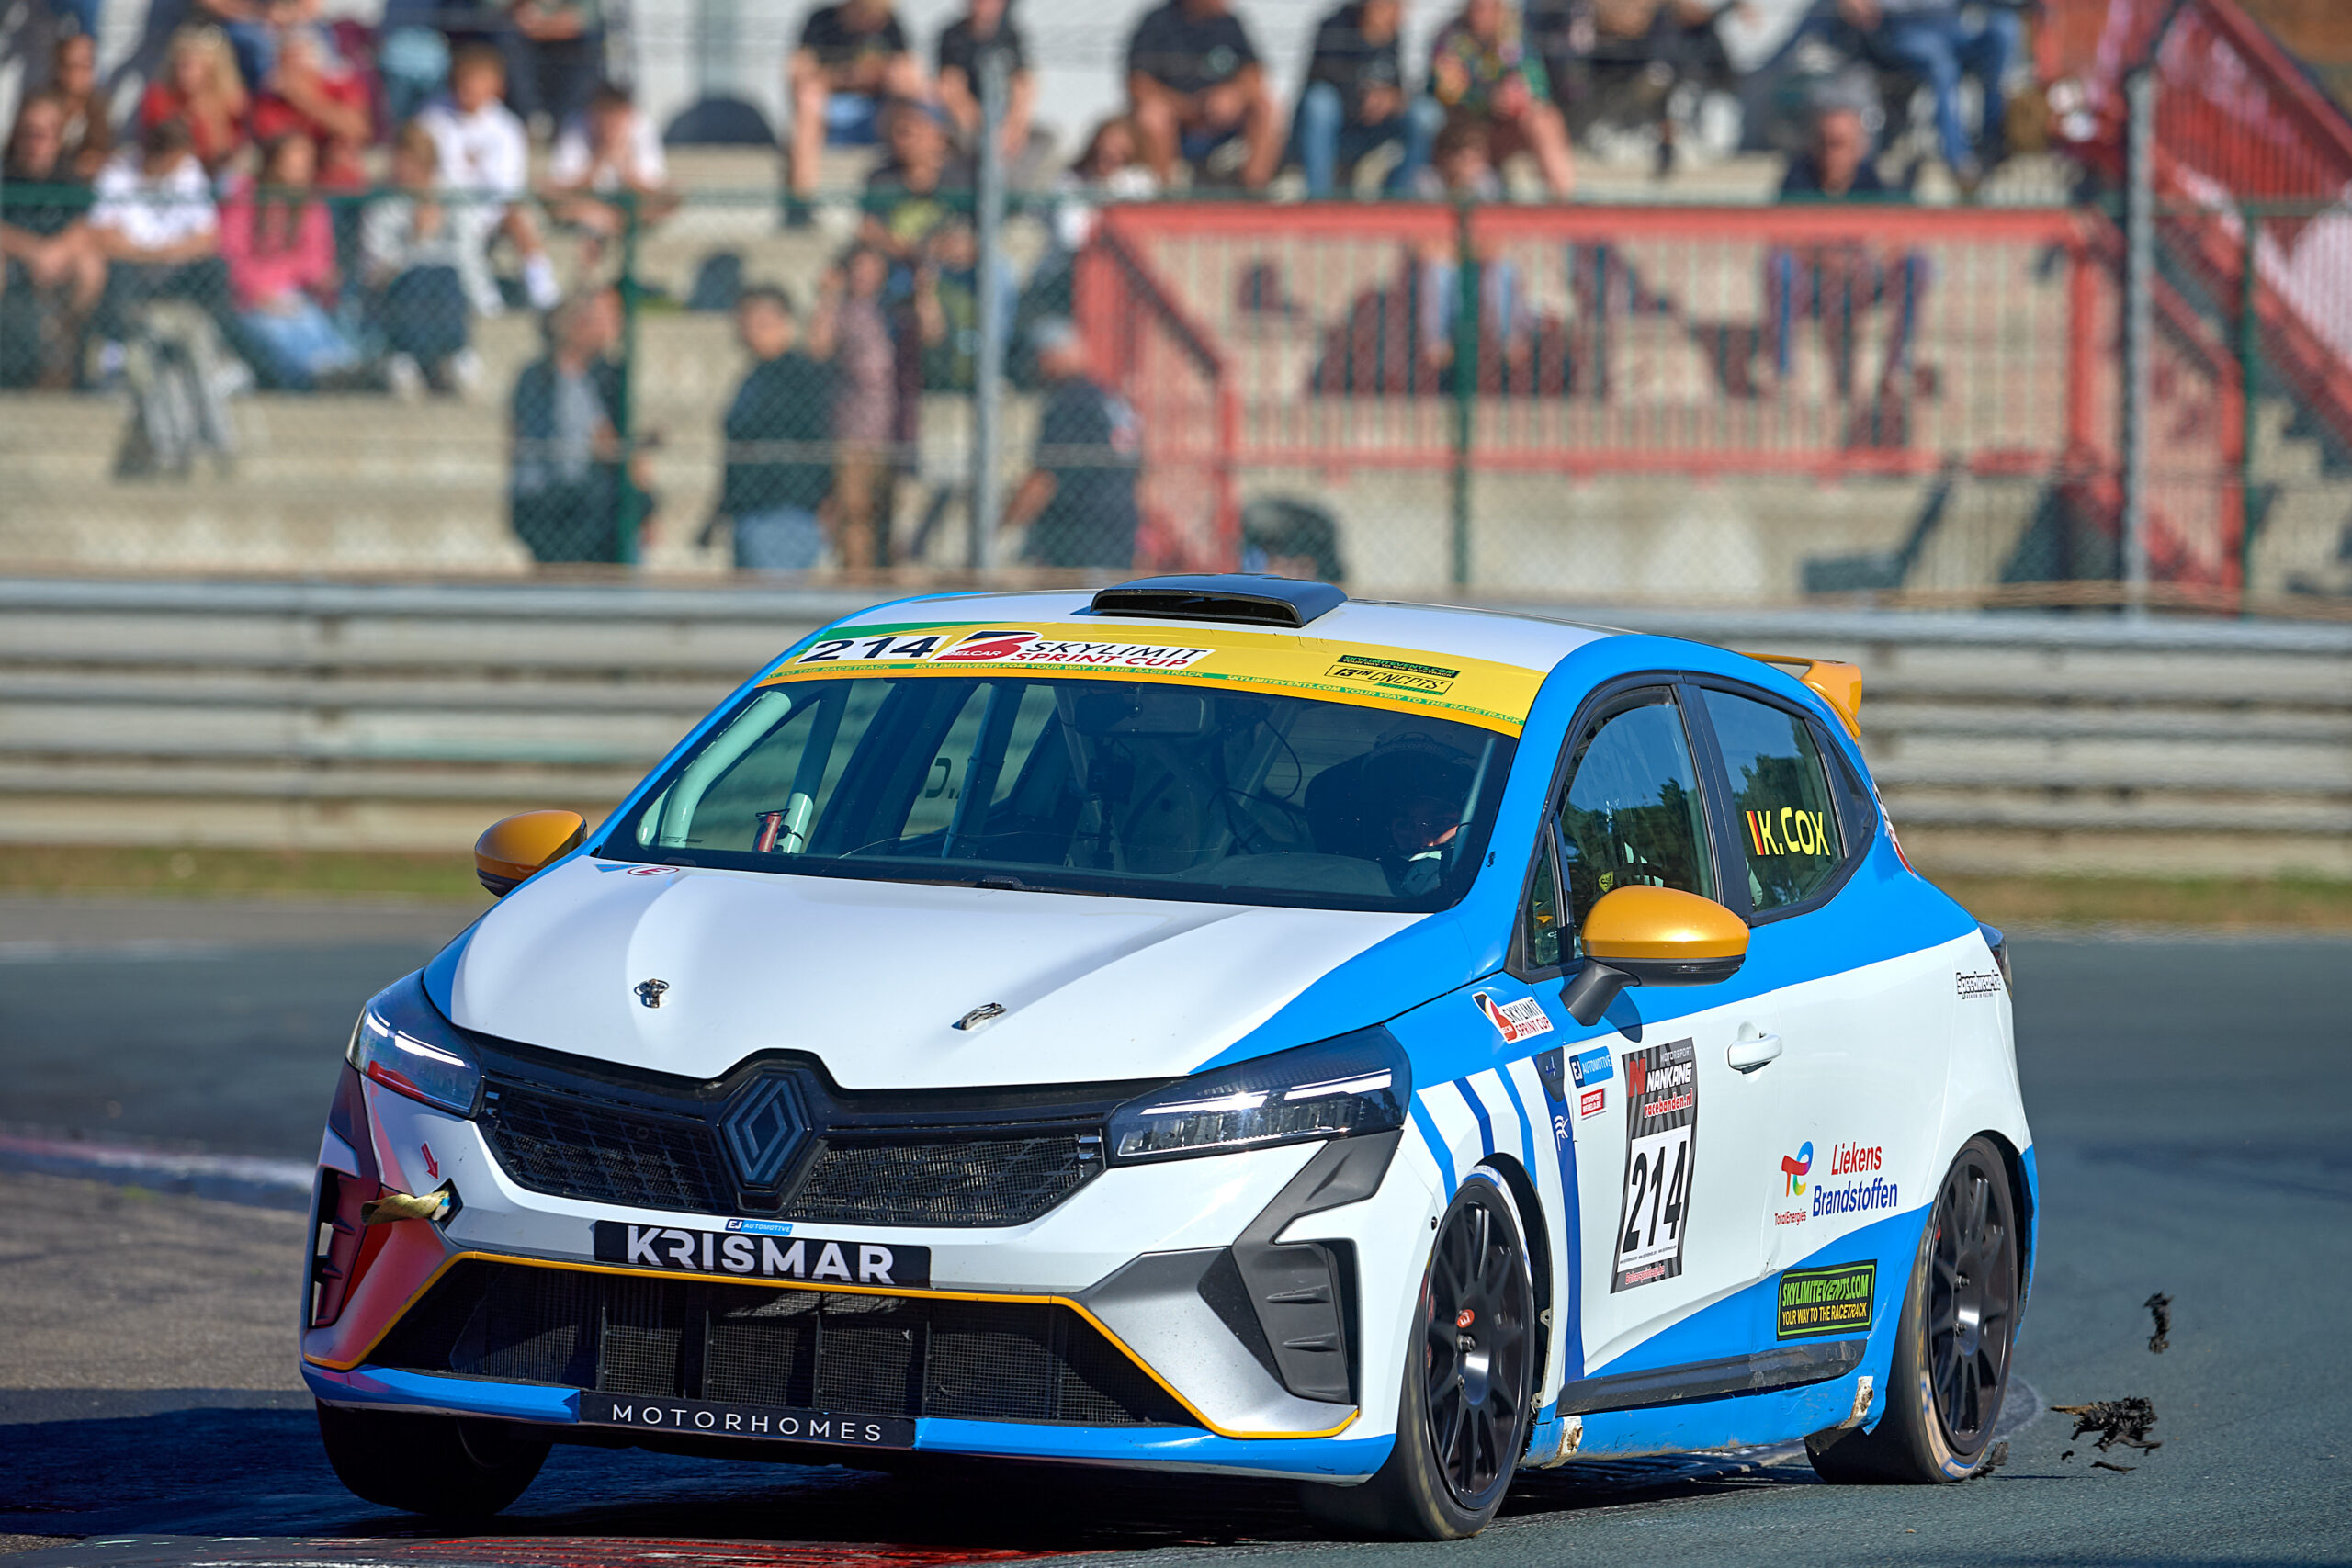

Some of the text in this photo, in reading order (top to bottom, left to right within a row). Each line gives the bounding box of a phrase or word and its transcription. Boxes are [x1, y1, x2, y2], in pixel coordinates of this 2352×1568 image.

[798, 636, 942, 663] 214
[1011, 653, 1188, 667] SPRINT CUP
[1026, 641, 1207, 660] SKYLIMIT
[1133, 668, 1204, 678] RACETRACK
[1343, 656, 1456, 675] SKYLIMITEVENTS.COM
[1368, 672, 1444, 690] CNCPTS
[1226, 674, 1341, 692] SKYLIMITEVENTS.COM
[1344, 687, 1376, 696] YOUR
[1378, 692, 1407, 701] WAY
[1425, 699, 1449, 708] THE
[1449, 705, 1521, 724] RACETRACK
[1501, 999, 1544, 1024] SKYLIMIT
[1515, 1020, 1540, 1037] SPRINT
[1536, 1016, 1551, 1031] CUP
[1660, 1046, 1692, 1062] MOTORSPORT
[1571, 1055, 1613, 1081] EJ AUTOMOTIVE
[1646, 1062, 1692, 1093] NANKANG
[1645, 1088, 1693, 1118] racebanden.nl
[1831, 1141, 1882, 1176] Liekens
[1622, 1140, 1687, 1254] 214
[1813, 1177, 1897, 1217] Brandstoffen
[727, 1220, 791, 1233] EJ AUTOMOTIVE
[1774, 1209, 1807, 1226] TotalEnergies
[628, 1225, 895, 1285] KRISMAR
[1782, 1274, 1870, 1306] SKYLIMITEVENTS.COM
[1782, 1302, 1867, 1325] YOUR WAY TO THE RACETRACK
[612, 1404, 881, 1442] MOTORHOMES
